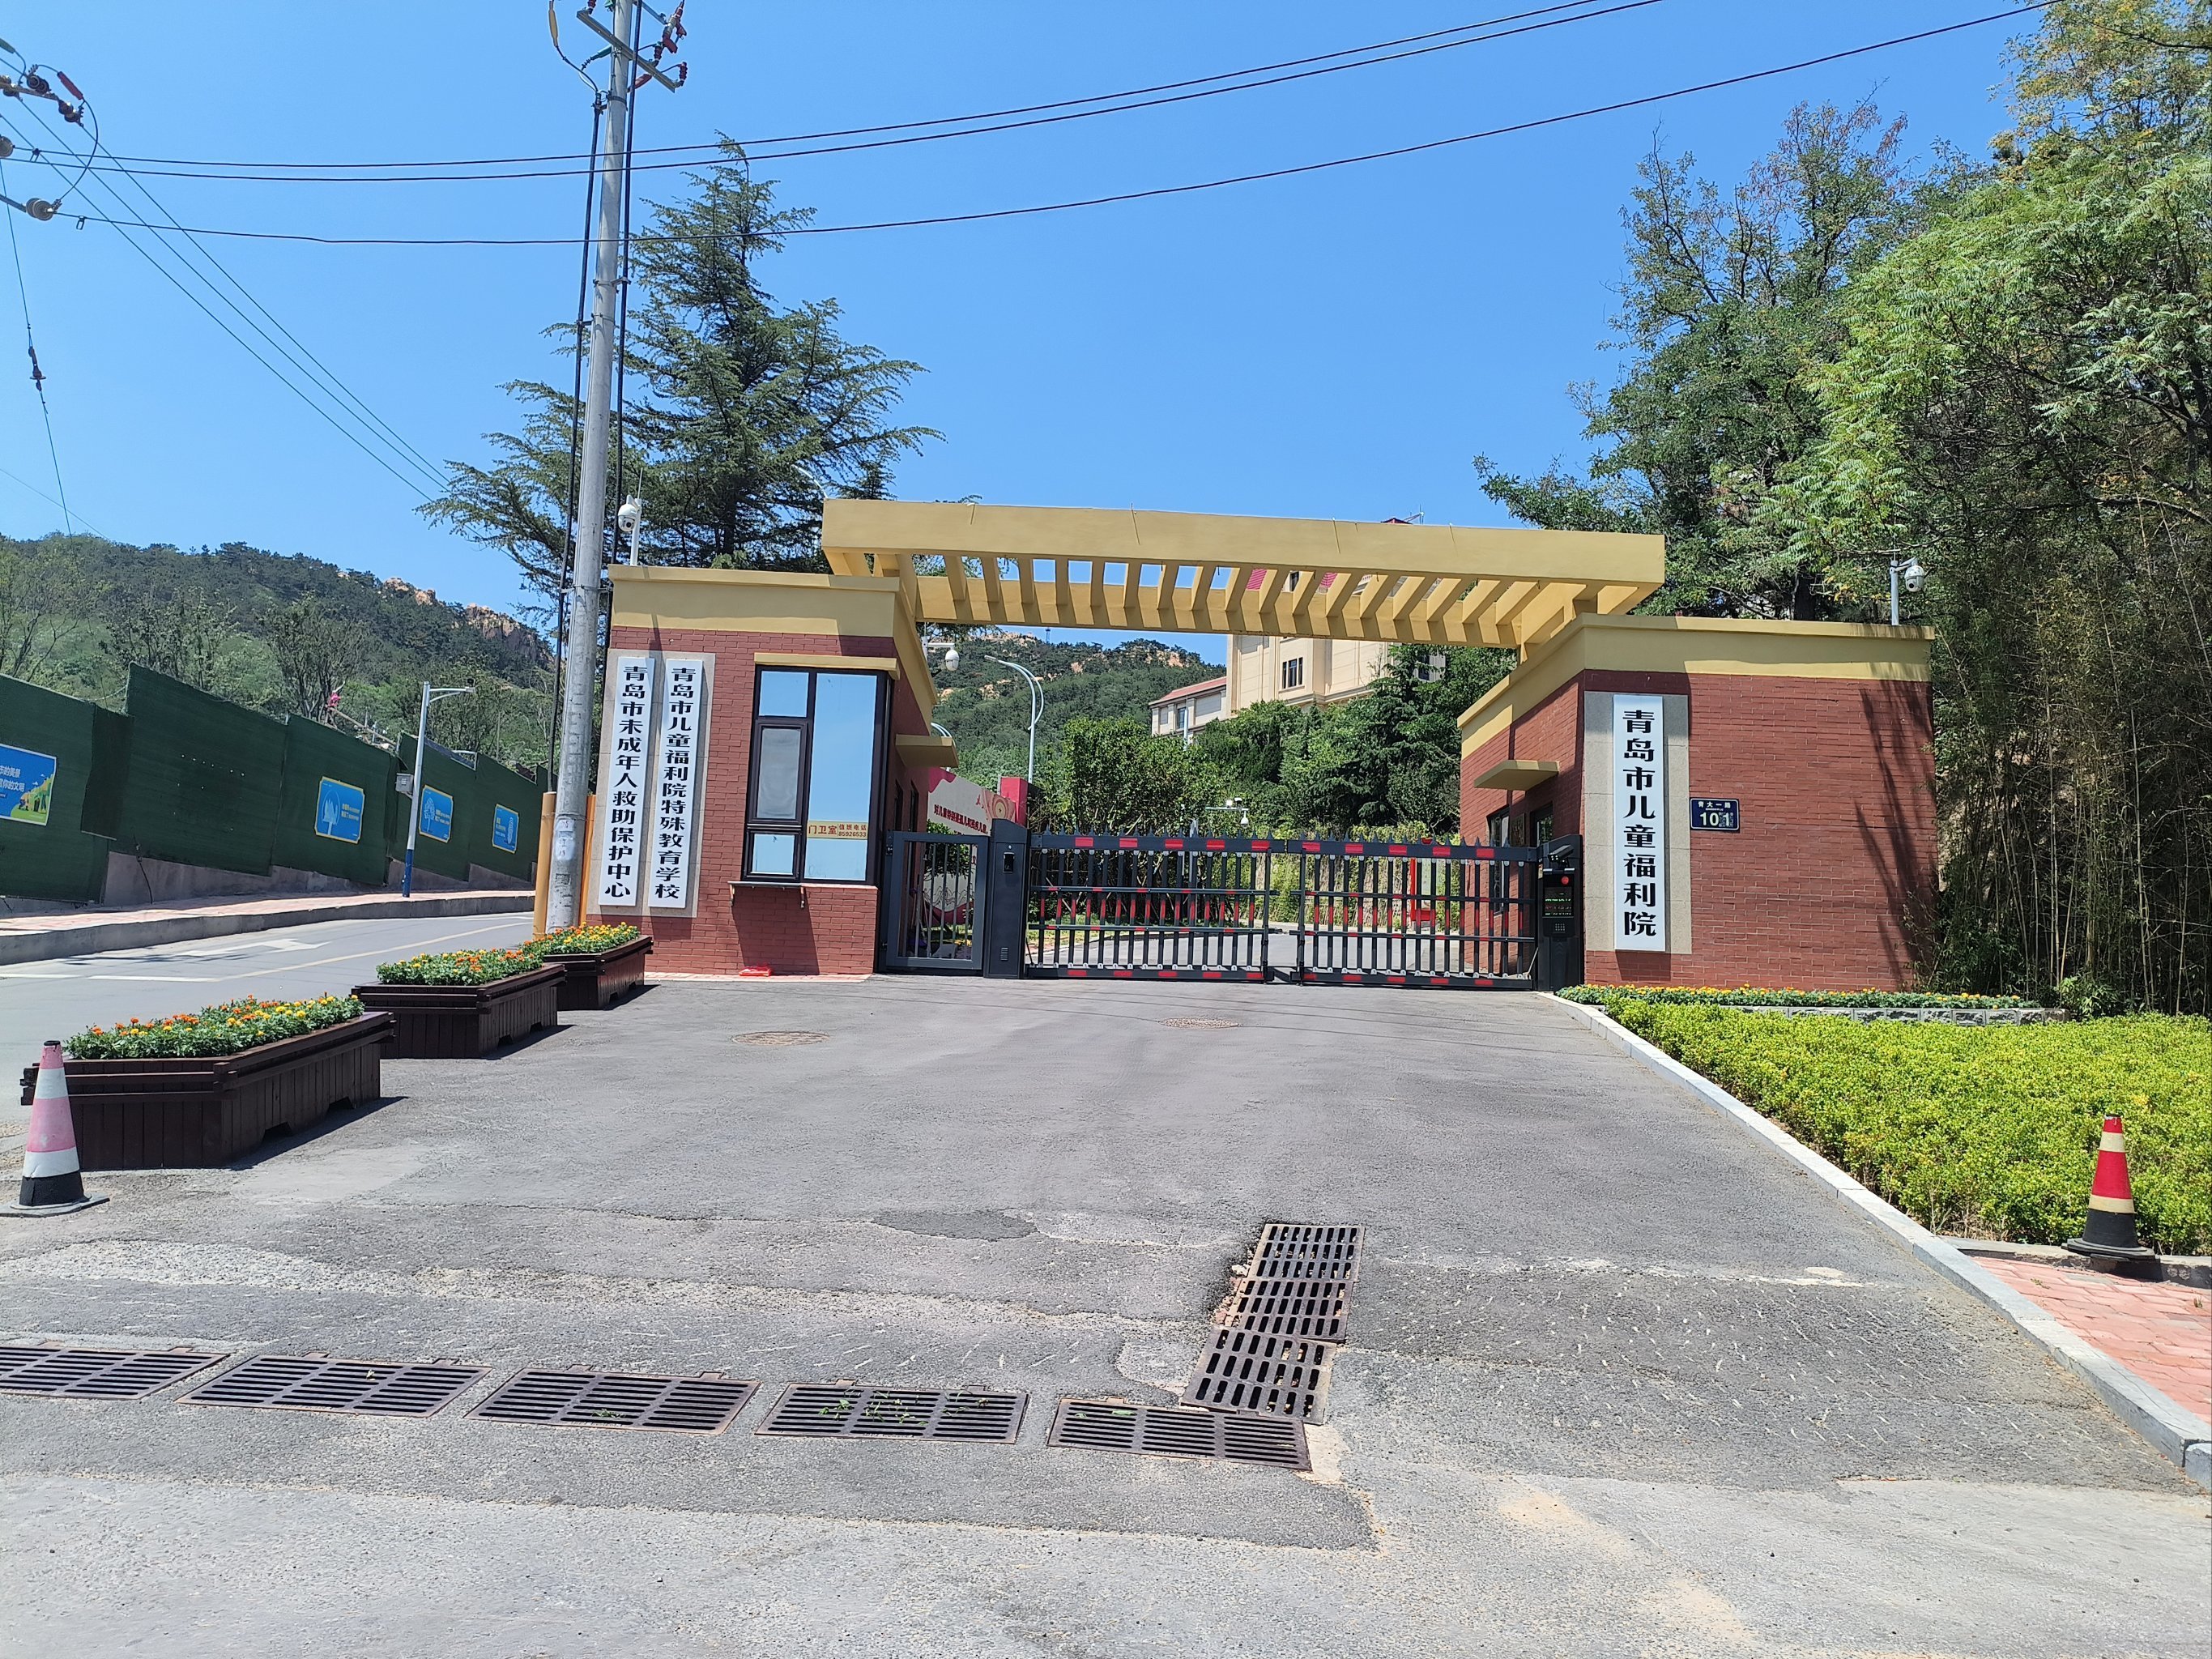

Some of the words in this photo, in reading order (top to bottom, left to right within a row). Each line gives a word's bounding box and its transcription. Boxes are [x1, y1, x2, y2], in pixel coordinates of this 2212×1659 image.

[604, 666, 648, 898] 青岛市未成年人救助保护中心
[654, 667, 697, 899] 青岛市儿童福利院特殊教育学校
[808, 825, 837, 835] 门卫室
[1622, 710, 1657, 936] 青岛市儿童福利院
[1699, 812, 1730, 826] 101
